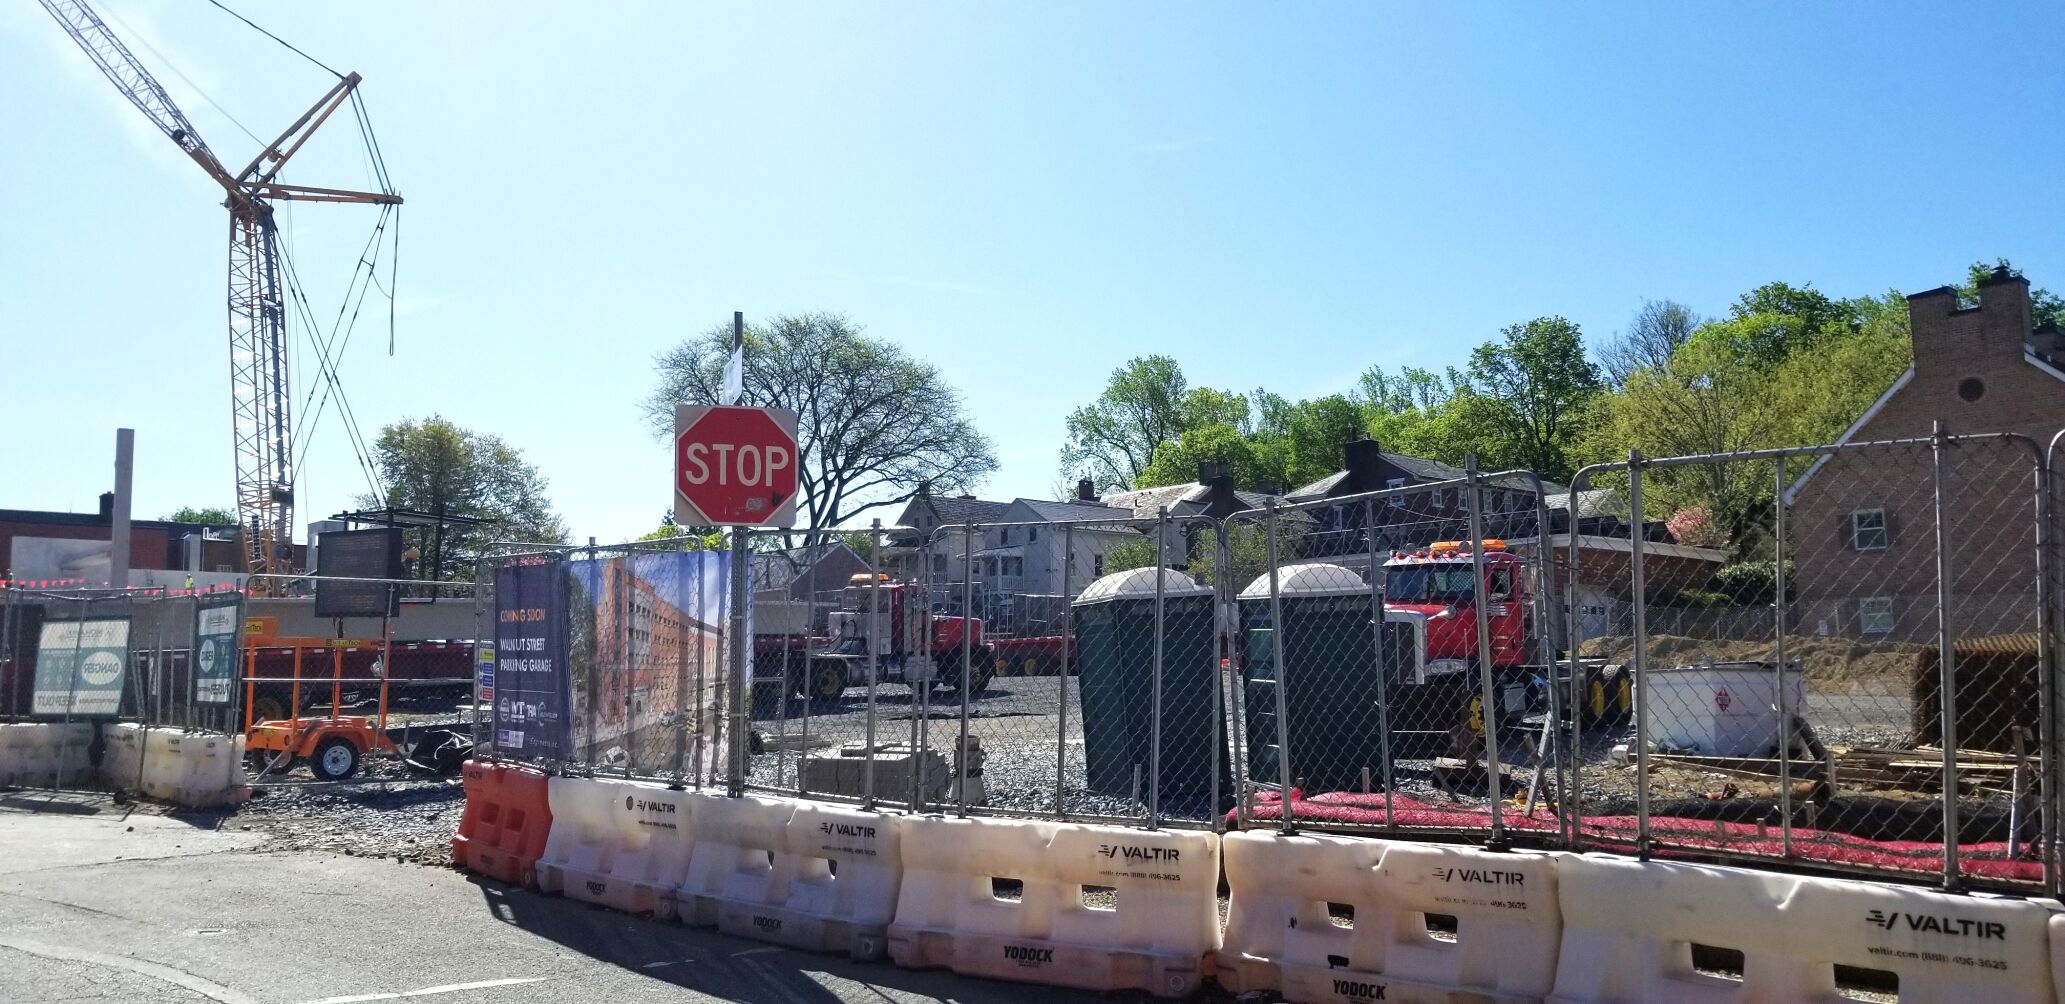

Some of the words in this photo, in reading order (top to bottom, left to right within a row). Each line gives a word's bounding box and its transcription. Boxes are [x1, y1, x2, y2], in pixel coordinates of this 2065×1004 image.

[685, 442, 789, 487] STOP
[500, 609, 526, 622] COMING
[527, 608, 545, 621] SOON
[500, 638, 525, 651] WALNUT
[526, 638, 546, 651] STREET
[500, 659, 527, 671] PARKING
[529, 659, 552, 672] GARAGE
[648, 801, 676, 814] VALTIR
[836, 824, 876, 838] VALTIR
[1121, 846, 1180, 861] VALTIR
[1458, 868, 1524, 886] VALTIR
[1904, 913, 2005, 940] VALTIR
[1004, 945, 1053, 962] YODOCK
[1867, 946, 1919, 959] valtir.com
[1952, 956, 2008, 970] 496-3625
[1333, 979, 1387, 1000] YODOCK
